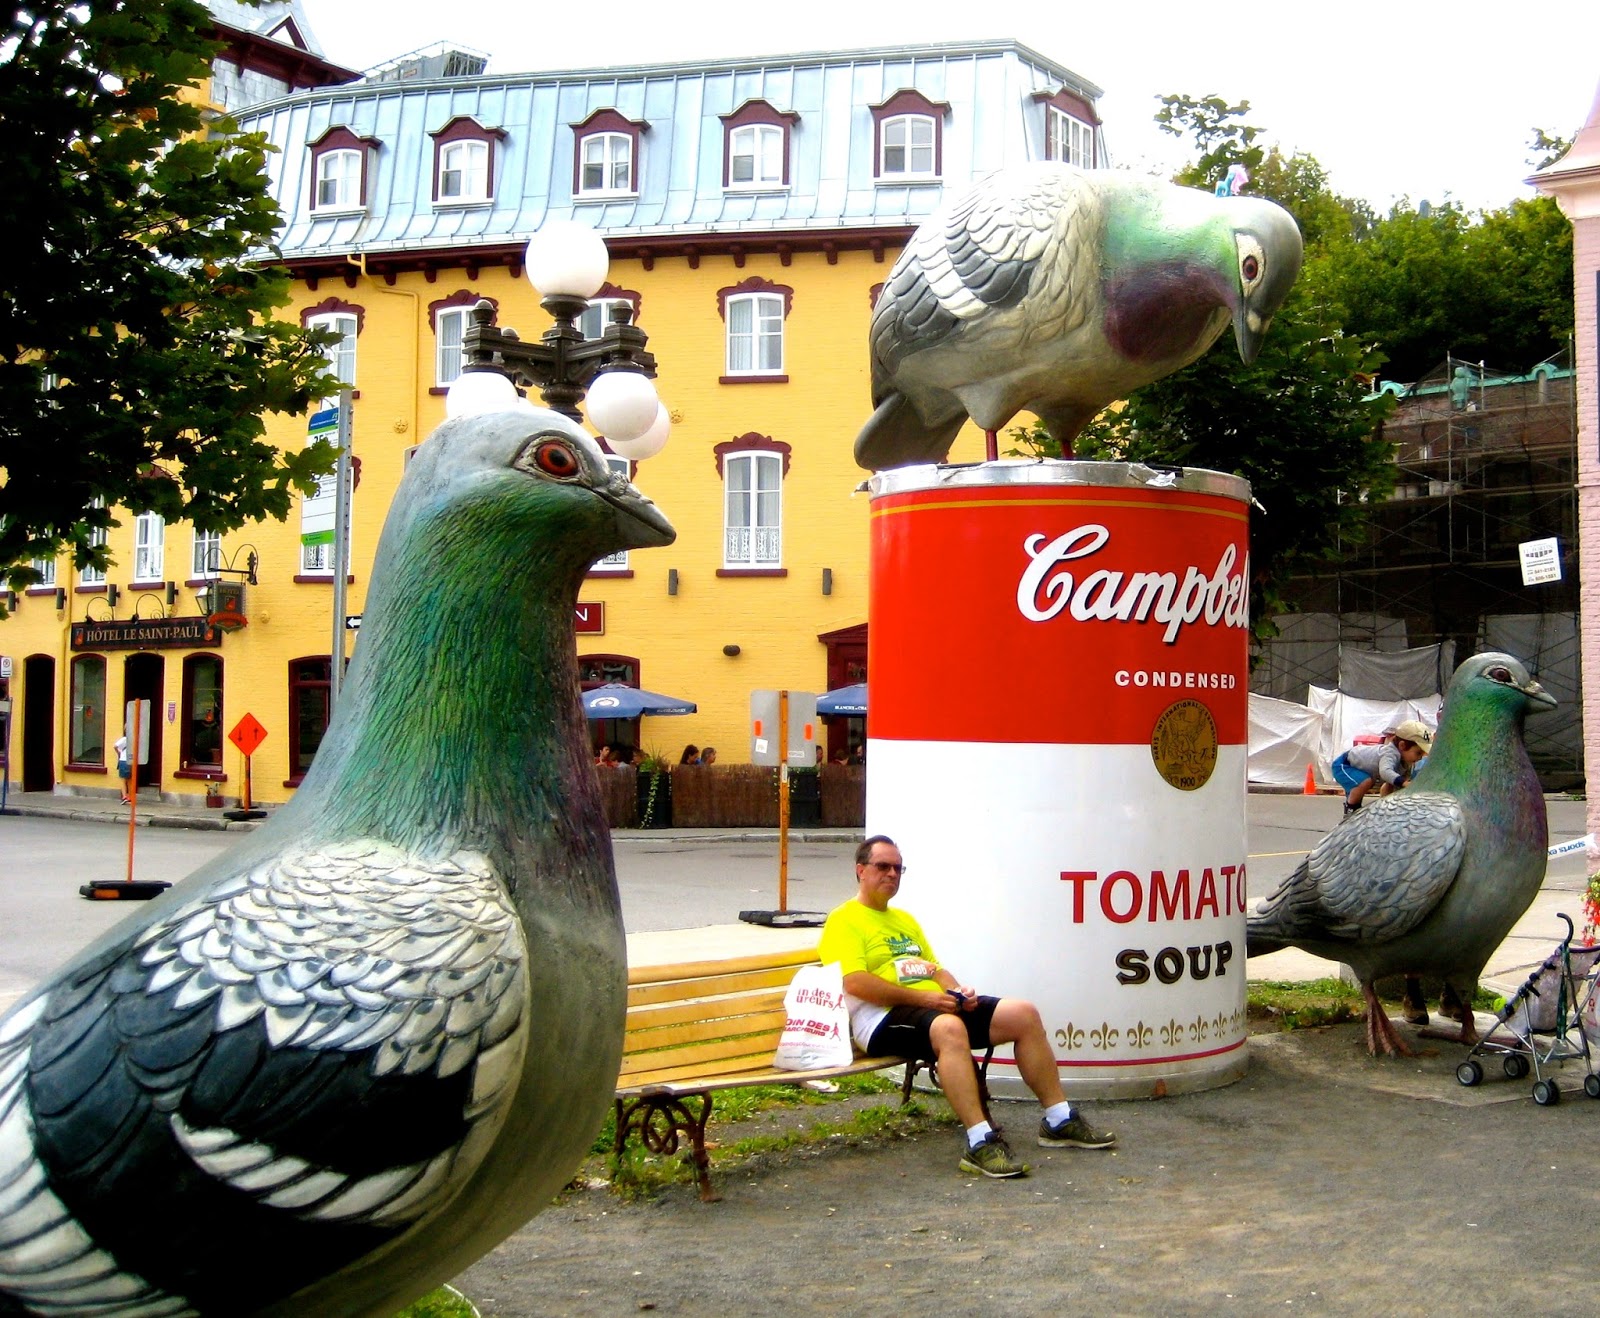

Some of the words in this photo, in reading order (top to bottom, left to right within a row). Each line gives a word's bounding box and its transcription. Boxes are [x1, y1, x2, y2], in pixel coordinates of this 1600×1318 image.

[86, 626, 121, 642] HÔTEL
[123, 629, 136, 641] LE
[138, 625, 201, 640] SAINT-PAUL
[1114, 670, 1236, 689] CONDENSED
[1157, 701, 1199, 732] INTERNATIONAL
[1180, 776, 1196, 787] 1900
[1558, 840, 1586, 852] sports
[1060, 863, 1247, 924] TOMATO
[1115, 940, 1233, 986] SOUP
[812, 987, 832, 1000] des
[807, 1019, 831, 1032] DES
